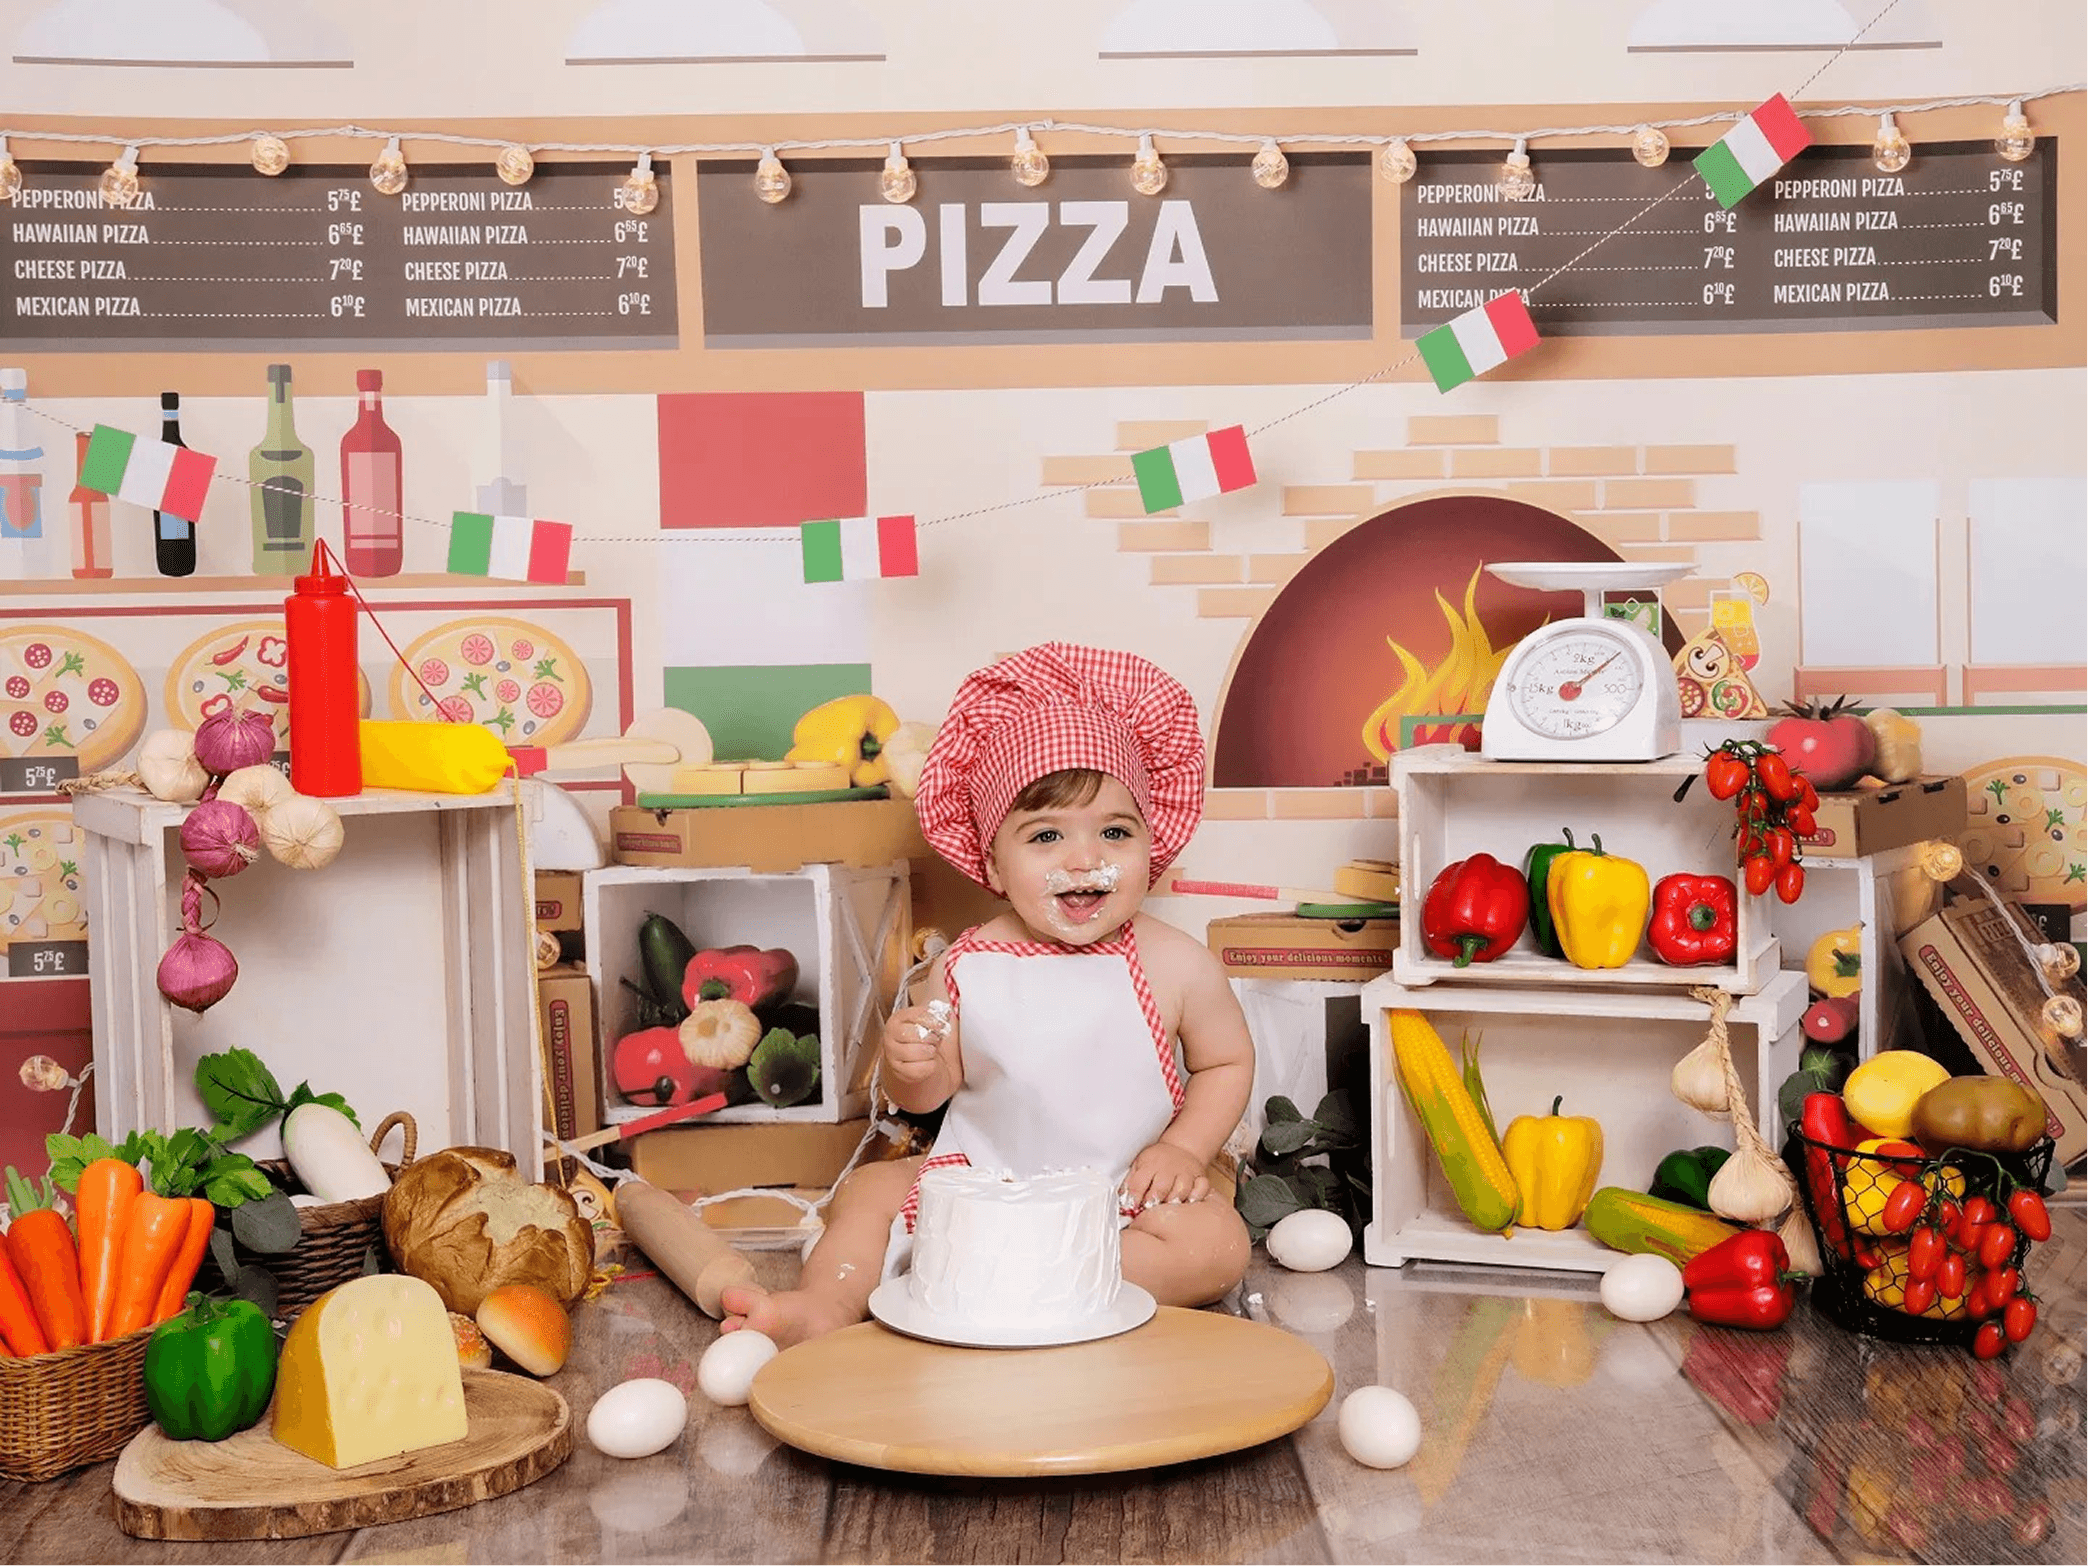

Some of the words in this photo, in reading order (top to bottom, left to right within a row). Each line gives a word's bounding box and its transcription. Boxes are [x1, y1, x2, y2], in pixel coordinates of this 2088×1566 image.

[1418, 185, 1499, 203] PEPPERONI
[1776, 179, 1856, 198] PEPPERONI
[1863, 178, 1904, 197] PIZZA
[11, 188, 104, 210] PEPPERONI
[402, 192, 486, 211] PEPPERONI
[491, 192, 532, 210] PIZZA
[1418, 218, 1492, 236] HAWAIIAN
[1499, 217, 1538, 235] PIZZA
[1775, 213, 1850, 232] HAWAIIAN
[1856, 211, 1897, 230] PIZZA
[14, 224, 97, 243] HAWAIIAN
[104, 225, 149, 243] PIZZA
[404, 226, 480, 245] HAWAIIAN
[486, 226, 527, 244] PIZZA
[860, 200, 1218, 307] PIZZA
[1419, 254, 1472, 272] CHEESE
[1477, 253, 1517, 271] PIZZA
[1775, 248, 1829, 267] CHEESE
[1834, 247, 1876, 266] PIZZA
[15, 260, 75, 279] CHEESE
[81, 261, 126, 279] PIZZA
[405, 262, 460, 280] CHEESE
[466, 262, 507, 280] PIZZA
[1417, 289, 1485, 309] MEXICAN
[1775, 284, 1840, 303] MEXICAN
[1847, 282, 1889, 301] PIZZA
[17, 297, 89, 315] MEXICAN
[96, 297, 140, 315] PIZZA
[406, 298, 473, 316] MEXICAN
[480, 298, 521, 316] PIZZA
[1230, 952, 1257, 964] Enjoy
[1261, 953, 1284, 963] your
[1287, 952, 1333, 964] delicious
[1925, 952, 1954, 989] Enjoy
[1949, 991, 1974, 1016] your
[1973, 1018, 2012, 1071] delicious
[553, 1009, 566, 1047] Enjoy
[555, 1049, 567, 1082] your
